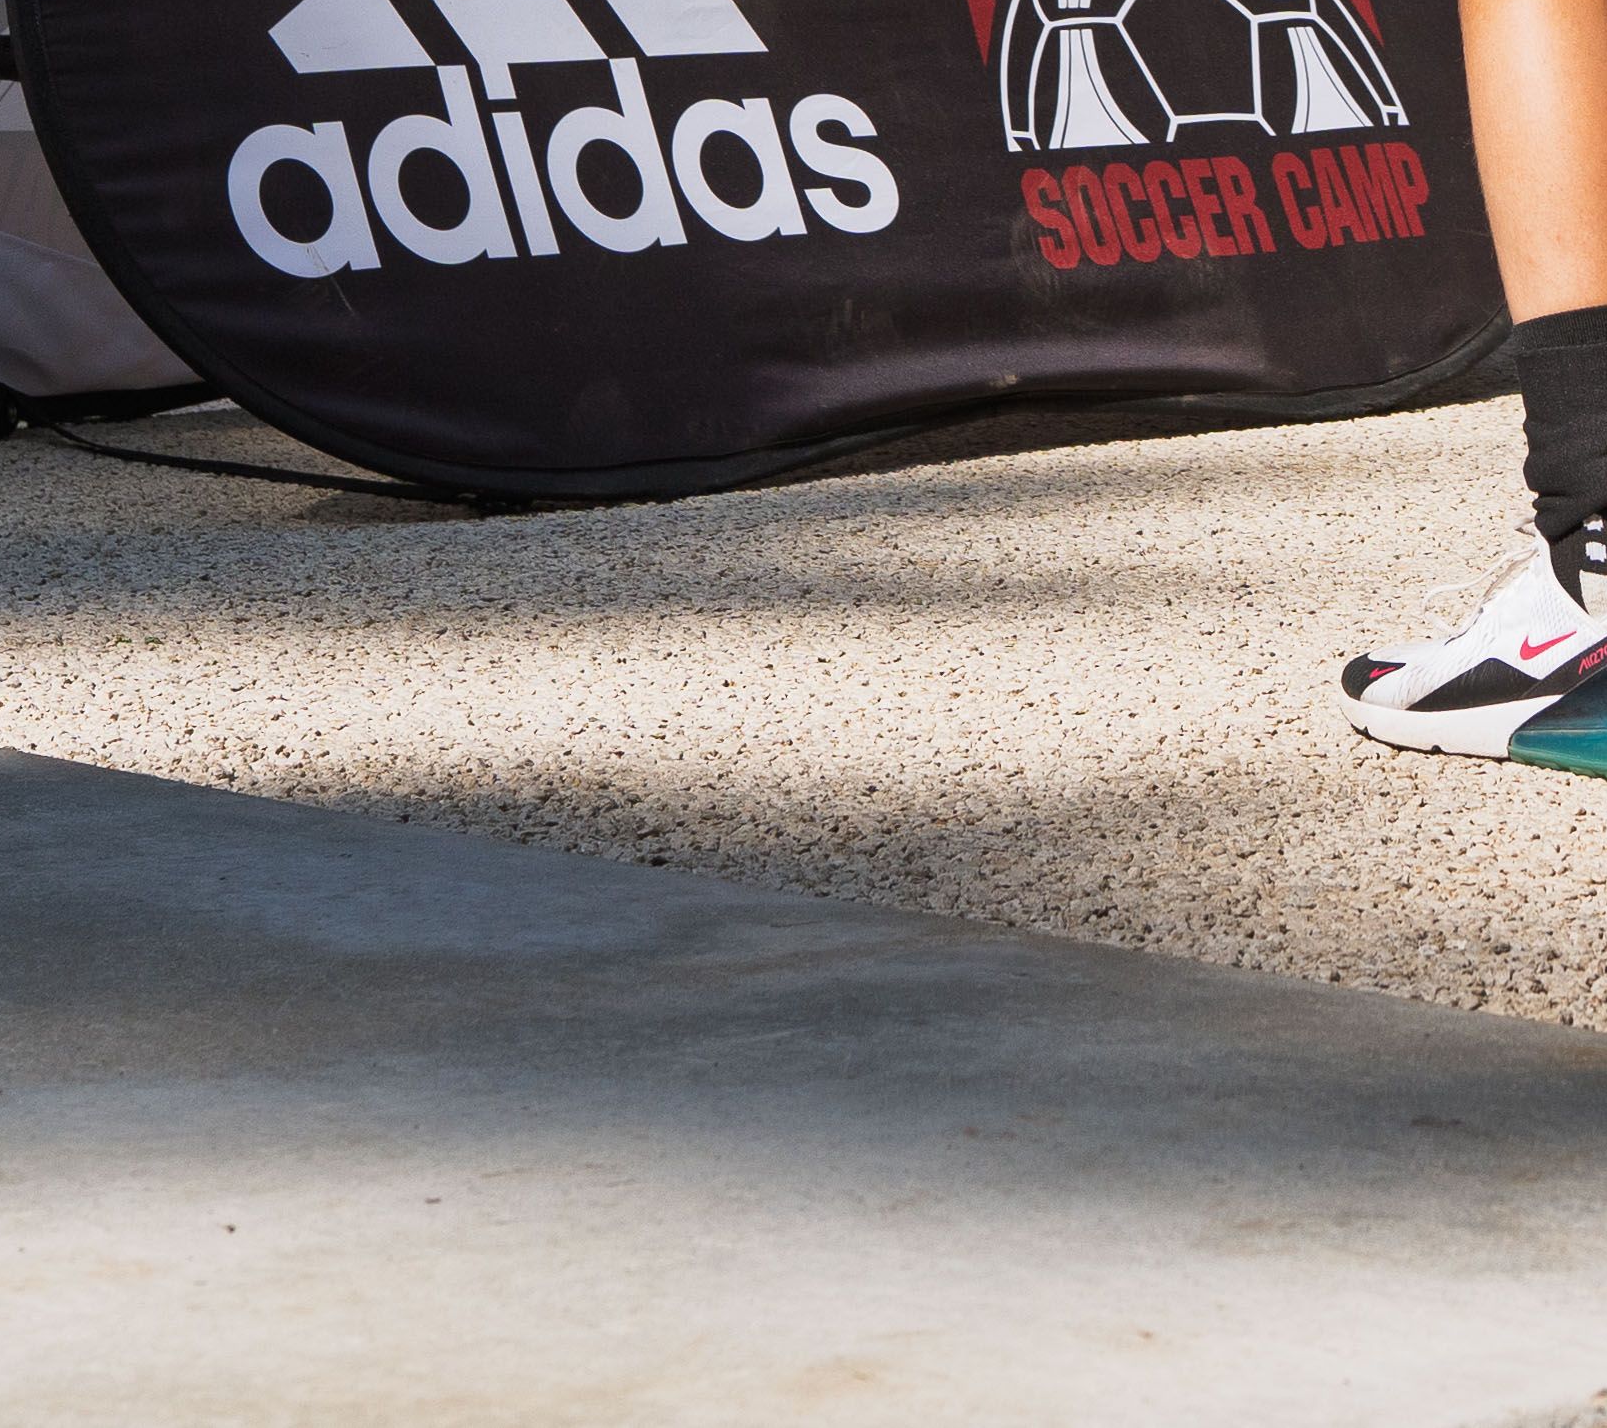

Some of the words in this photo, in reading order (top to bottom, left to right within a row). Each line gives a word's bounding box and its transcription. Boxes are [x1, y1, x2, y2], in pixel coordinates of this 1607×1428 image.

[229, 57, 899, 277] adidas
[1021, 156, 1276, 269] SOCCER
[1273, 142, 1429, 249] CAMP
